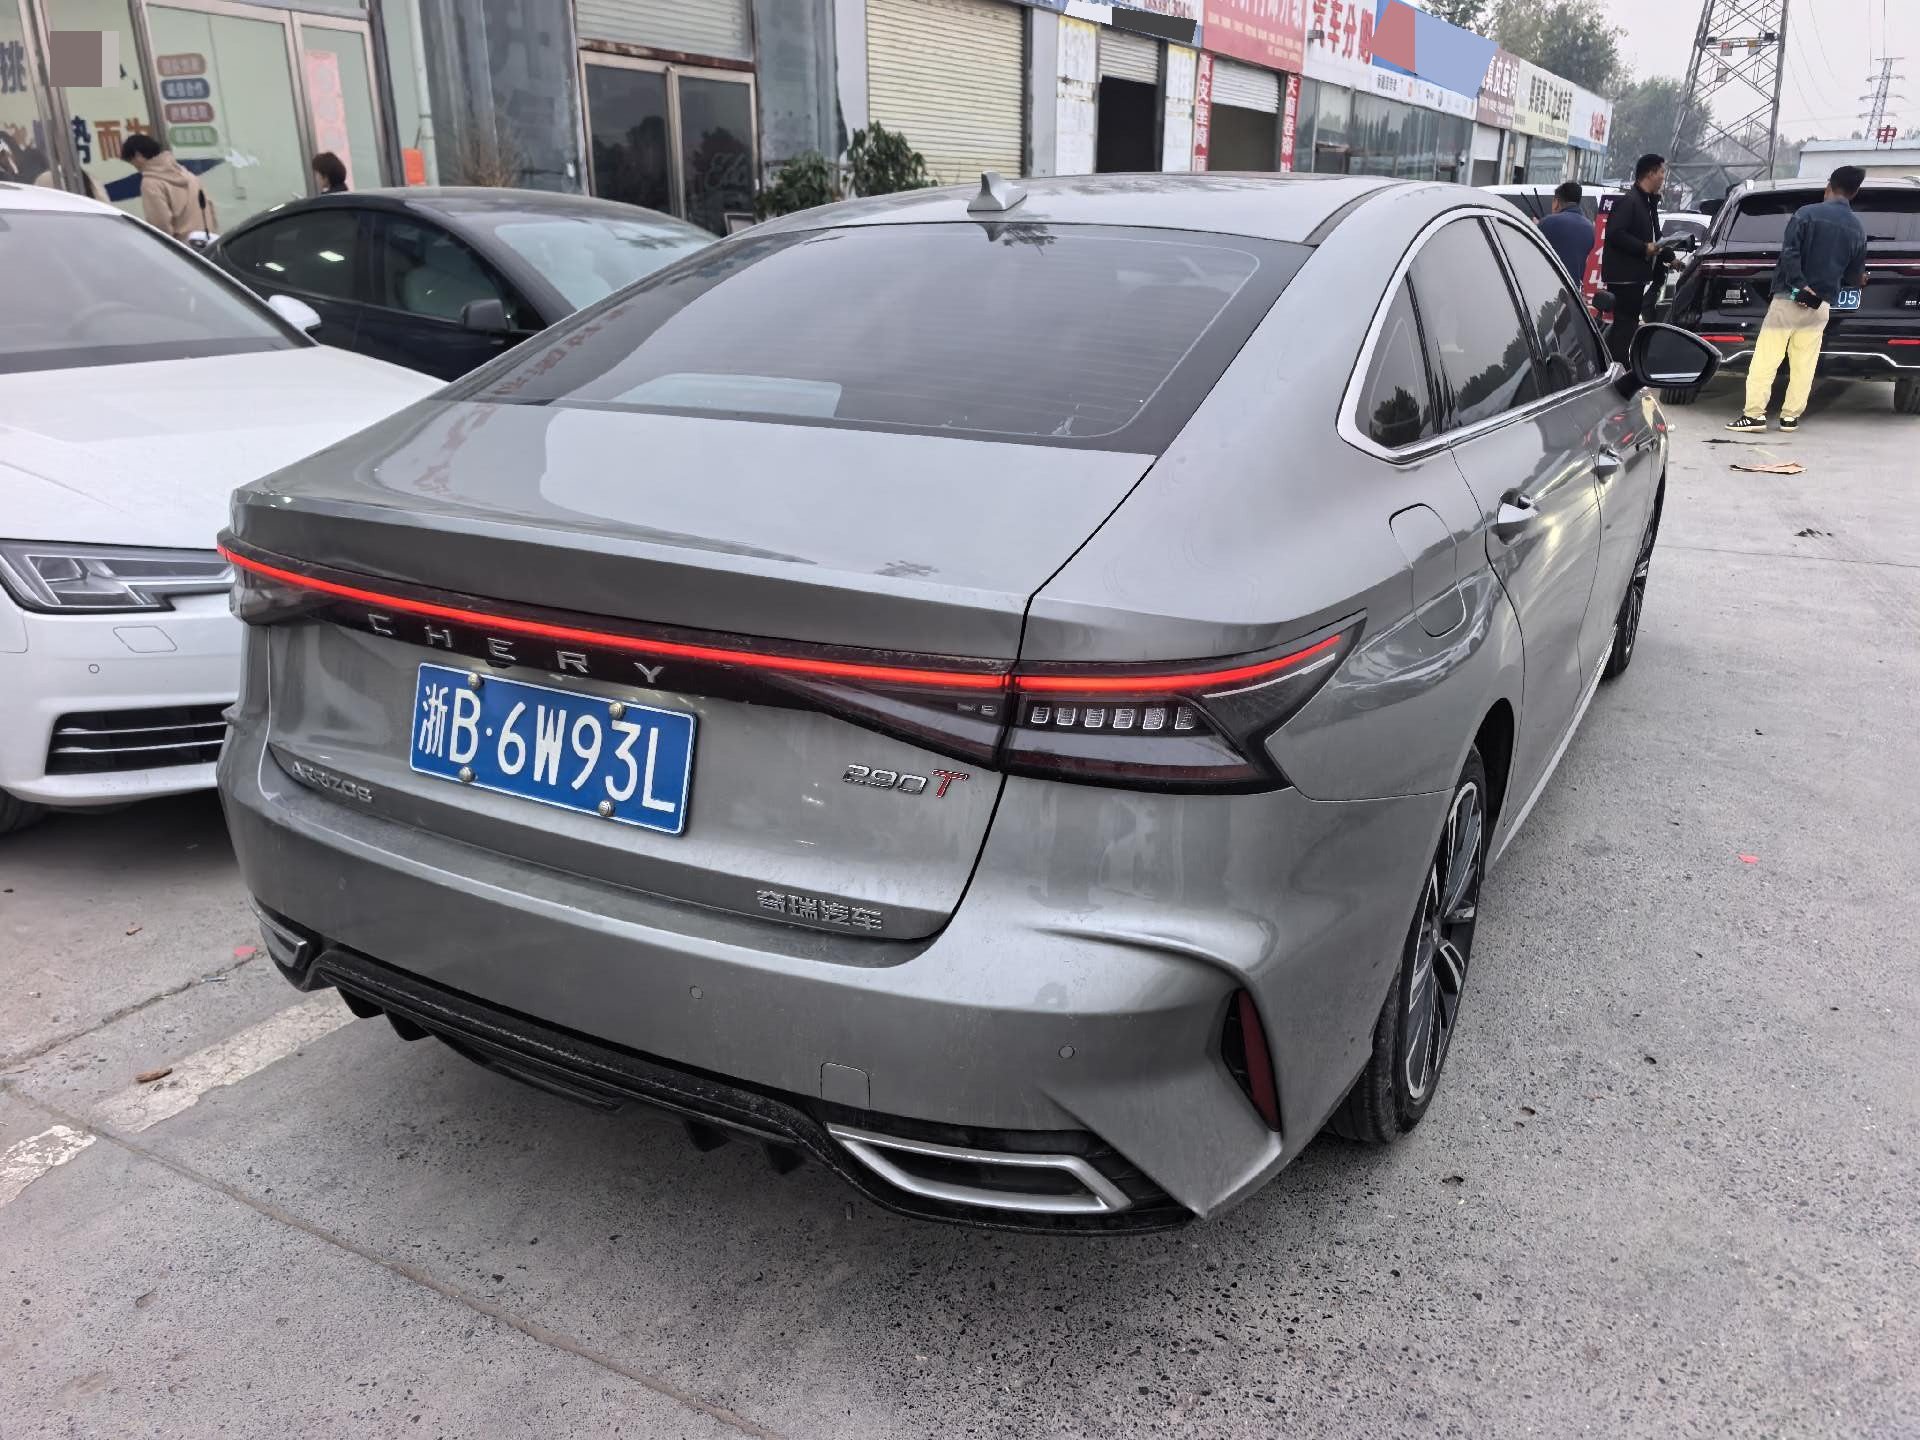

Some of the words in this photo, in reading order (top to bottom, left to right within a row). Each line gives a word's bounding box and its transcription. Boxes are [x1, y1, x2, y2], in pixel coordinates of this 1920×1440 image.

[367, 612, 664, 684] CHERY
[842, 764, 969, 798] 290T
[755, 889, 883, 931] 奇瑞汽车
